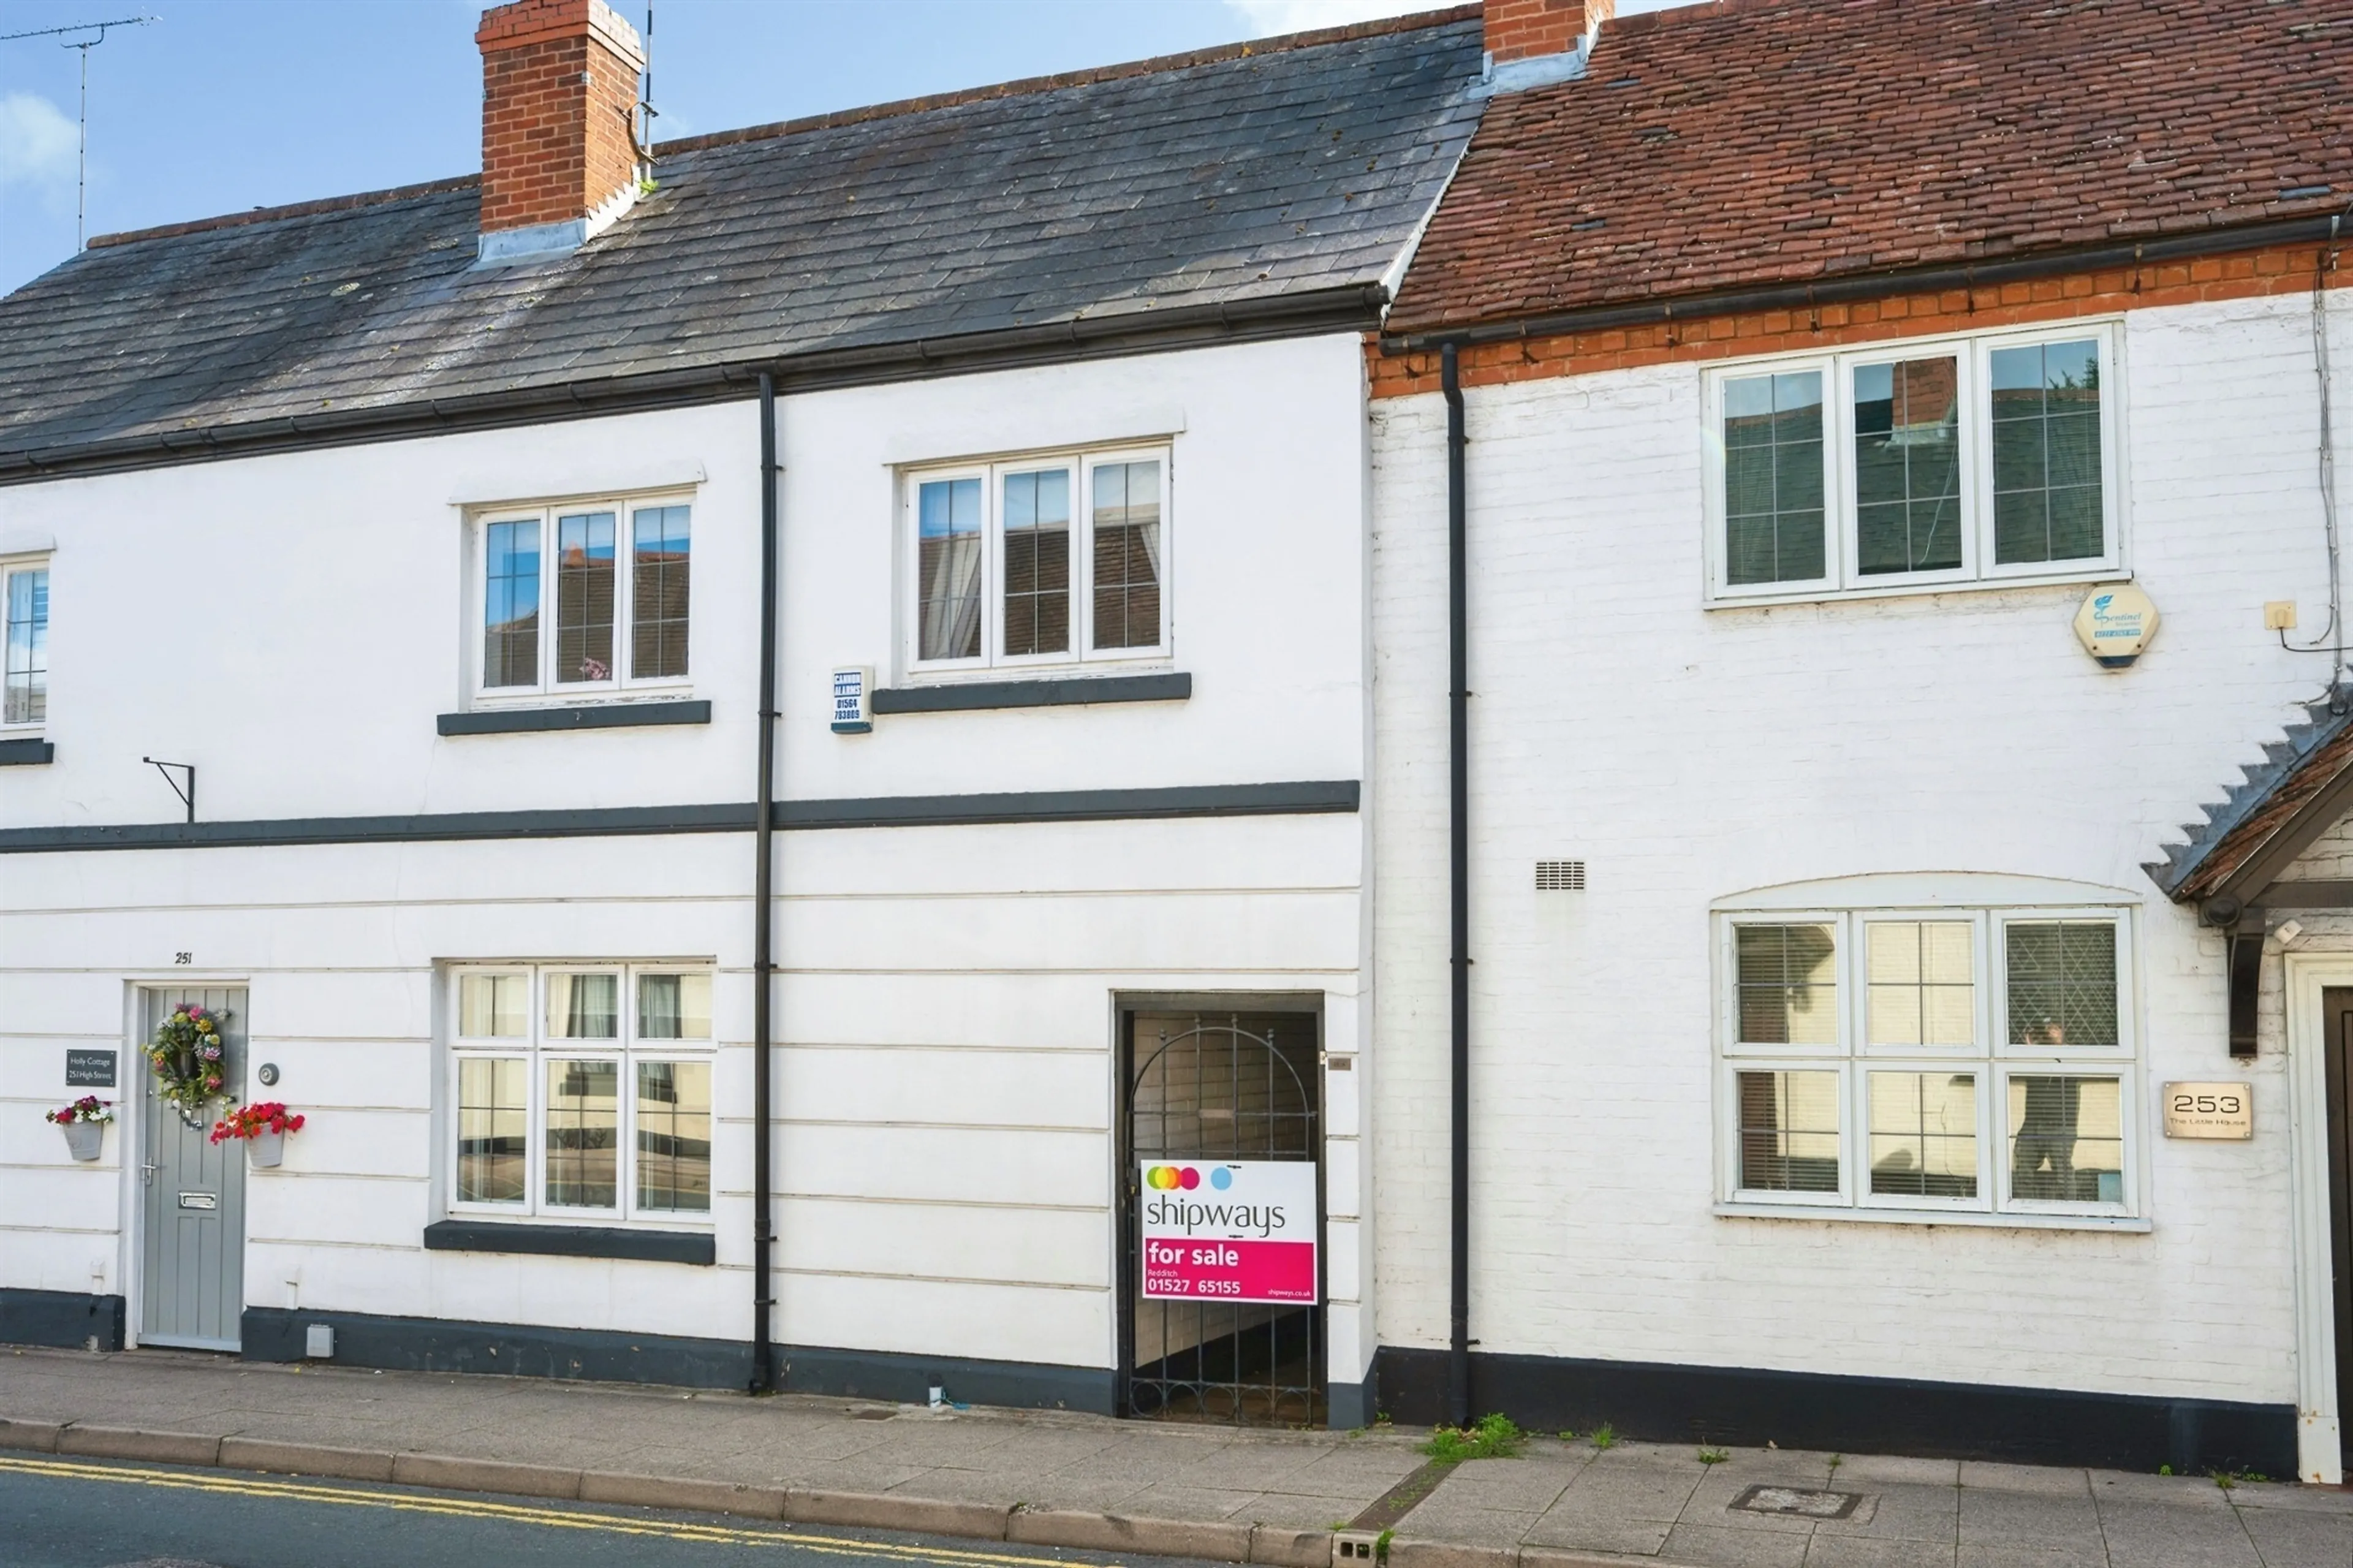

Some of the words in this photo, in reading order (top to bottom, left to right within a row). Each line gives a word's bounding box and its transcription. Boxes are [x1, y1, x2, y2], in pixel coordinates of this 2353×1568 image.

[2094, 612, 2142, 624] Sentinel
[837, 699, 857, 708] 01564
[175, 952, 192, 964] 251
[70, 1057, 85, 1067] Holly
[87, 1057, 110, 1067] Cottage
[80, 1070, 93, 1080] High
[2174, 1095, 2240, 1114] 253
[1147, 1194, 1286, 1238] shipways
[1148, 1241, 1184, 1264] for
[1192, 1244, 1239, 1267] sale
[1148, 1278, 1190, 1292] 01527
[1198, 1279, 1240, 1294] 65155
[1267, 1289, 1311, 1298] shipways.co.uk
